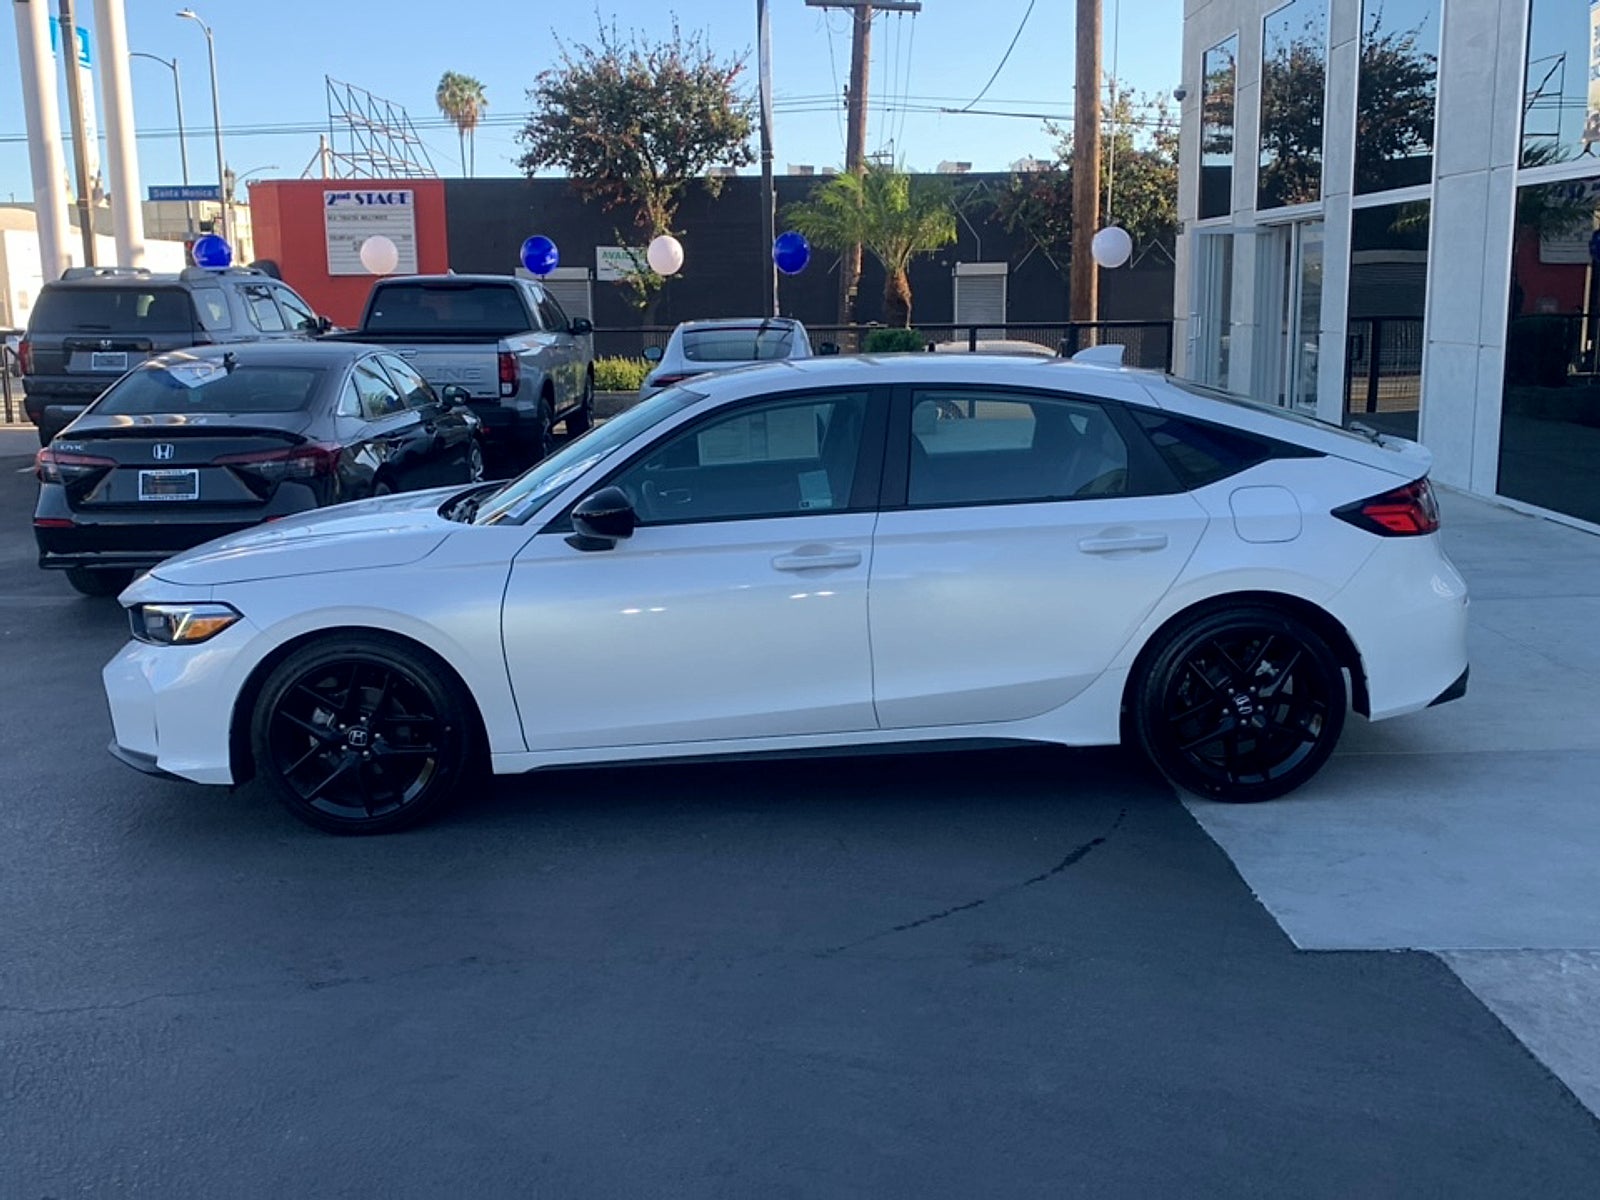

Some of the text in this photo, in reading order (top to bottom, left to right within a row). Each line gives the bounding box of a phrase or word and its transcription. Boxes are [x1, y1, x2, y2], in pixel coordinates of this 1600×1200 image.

[153, 188, 179, 198] Santa
[181, 188, 213, 198] Monica
[327, 191, 408, 206] 2nd STAGE
